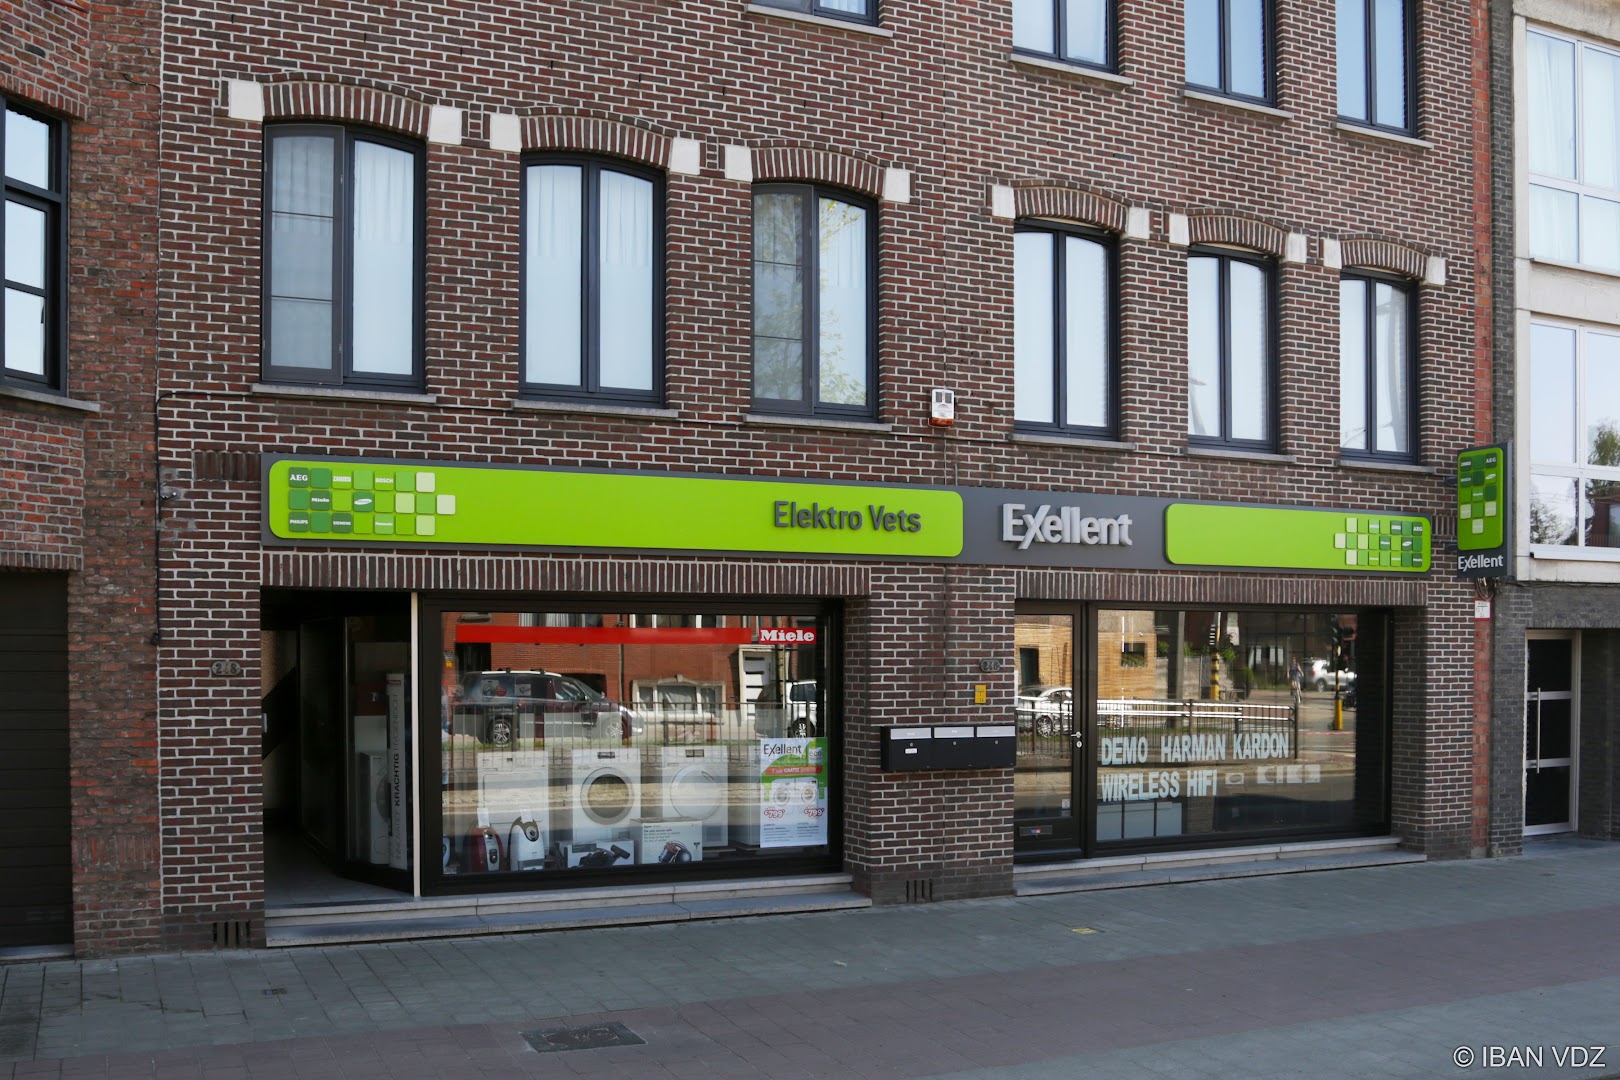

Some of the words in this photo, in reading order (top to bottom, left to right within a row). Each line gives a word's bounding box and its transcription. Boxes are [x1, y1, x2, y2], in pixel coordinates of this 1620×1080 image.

[774, 500, 863, 531] Elektro
[868, 504, 922, 533] Vets
[1002, 502, 1133, 550] Exellent
[1457, 554, 1504, 572] Exellent
[760, 629, 815, 642] Miele
[763, 743, 802, 757] Exellent
[1101, 736, 1148, 766] DEMO
[1161, 733, 1226, 763] HARMAN
[1232, 732, 1290, 760] KARDON
[1100, 771, 1181, 803] WIRELESS
[1186, 769, 1218, 798] HIFI
